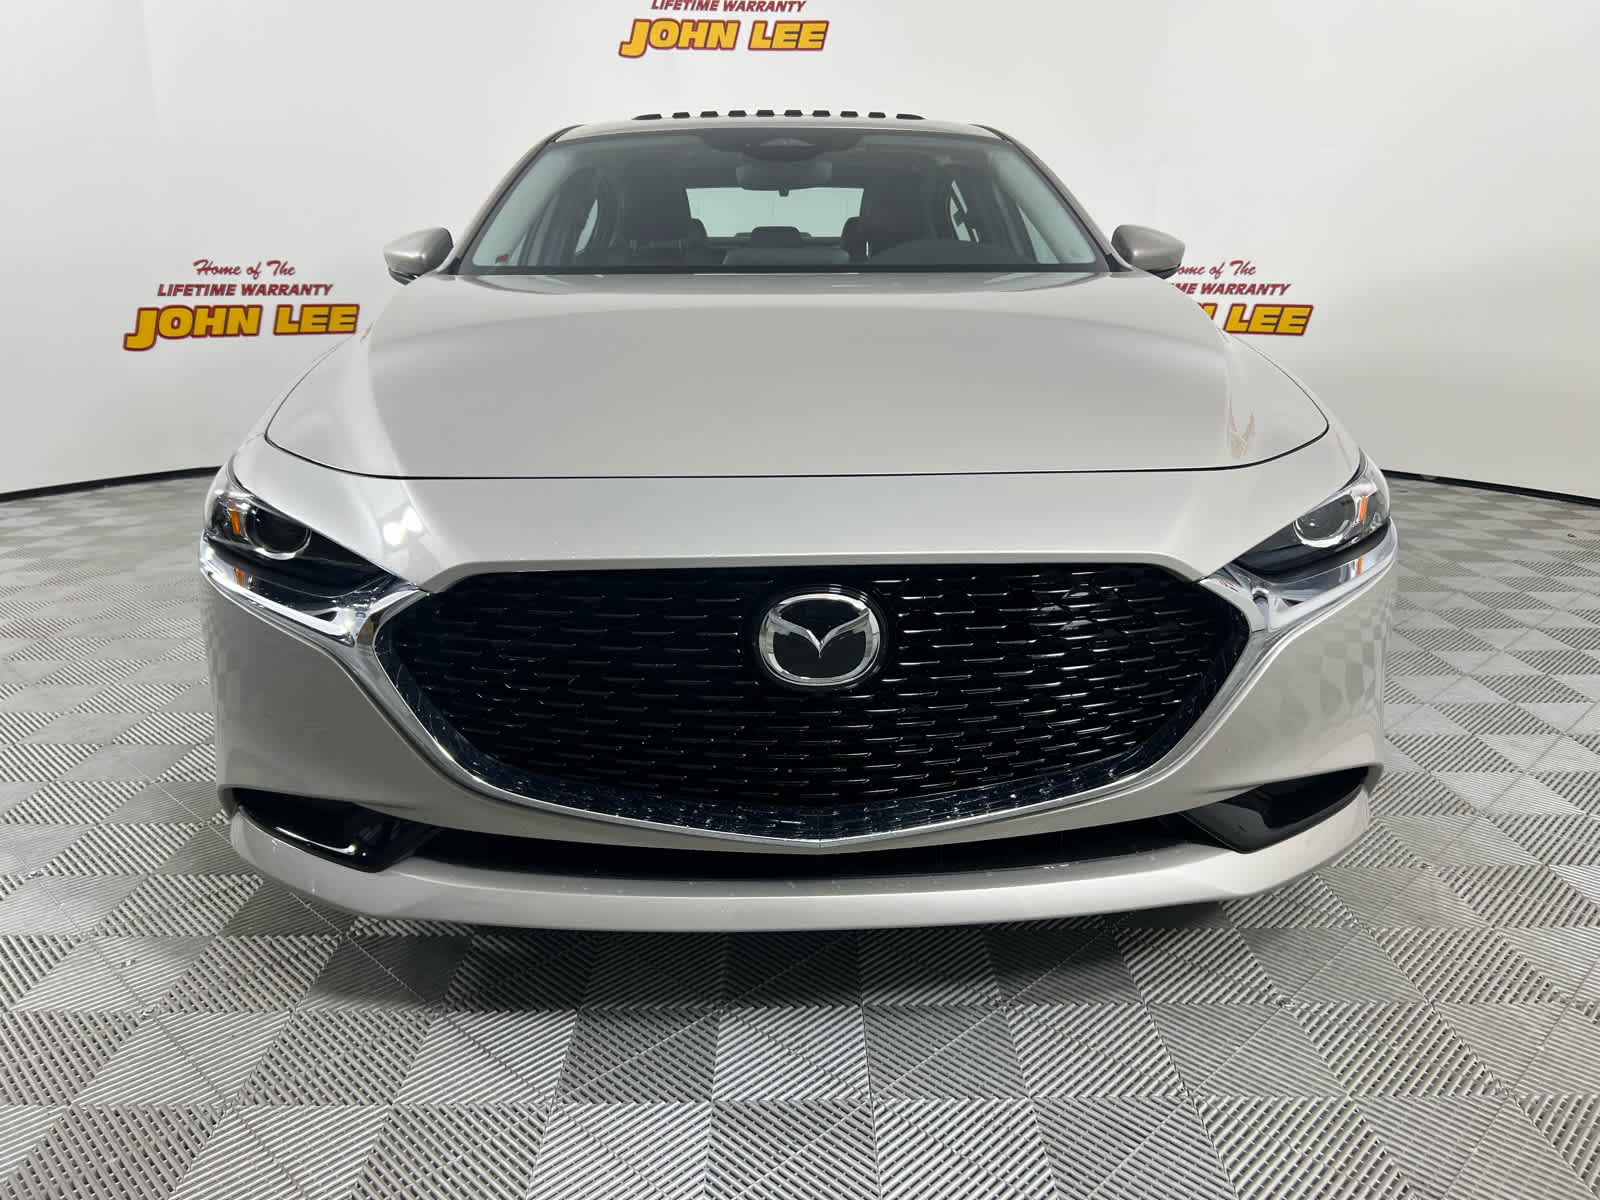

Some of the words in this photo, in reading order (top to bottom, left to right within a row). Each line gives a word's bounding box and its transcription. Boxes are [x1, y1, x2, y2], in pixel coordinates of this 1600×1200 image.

[651, 0, 719, 11] LIFETIME
[722, 0, 806, 12] WARRANTY
[618, 18, 741, 59] JOHN
[747, 20, 830, 51] LEE
[193, 259, 241, 276] Home
[246, 261, 262, 280] of
[266, 260, 296, 276] The
[1176, 265, 1206, 275] ome
[1209, 261, 1225, 279] of
[1229, 260, 1256, 275] The
[157, 284, 237, 296] LIFETIME
[241, 284, 333, 296] WARRANTY
[1200, 283, 1291, 295] WARRANTY
[123, 305, 263, 351] JOHN
[273, 303, 360, 336] LEE
[1222, 303, 1314, 336] LEE
